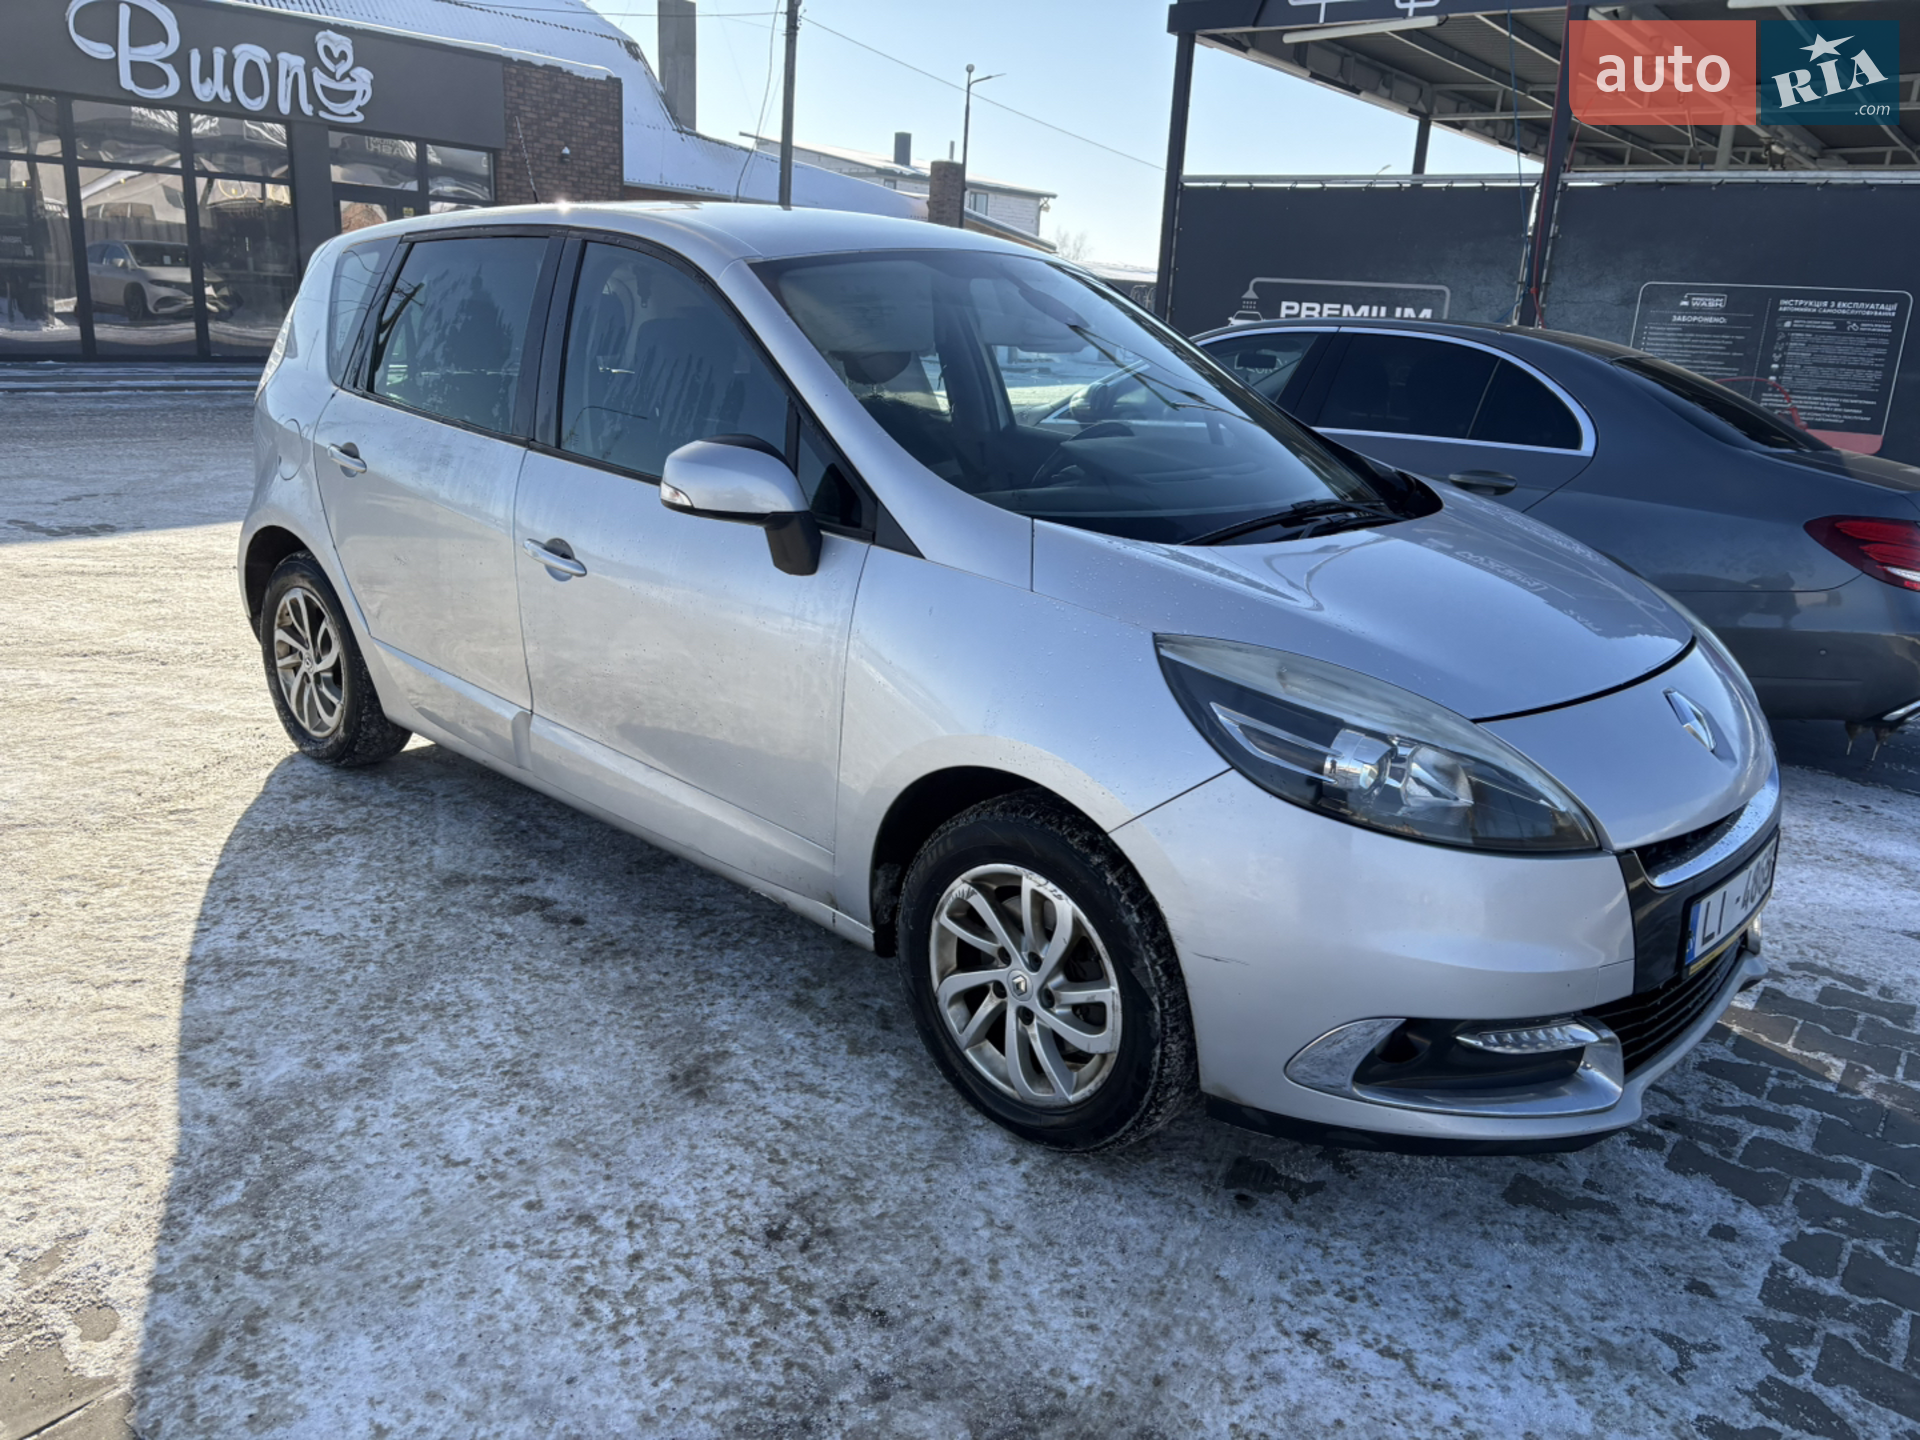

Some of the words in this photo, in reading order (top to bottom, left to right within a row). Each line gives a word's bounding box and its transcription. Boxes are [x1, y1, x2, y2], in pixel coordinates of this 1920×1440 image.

[1779, 299, 1829, 308] ІНСТРУКЦІЯ
[1279, 300, 1433, 319] PREMIUM
[1671, 315, 1727, 324] ЗАБОРОНЕНО:
